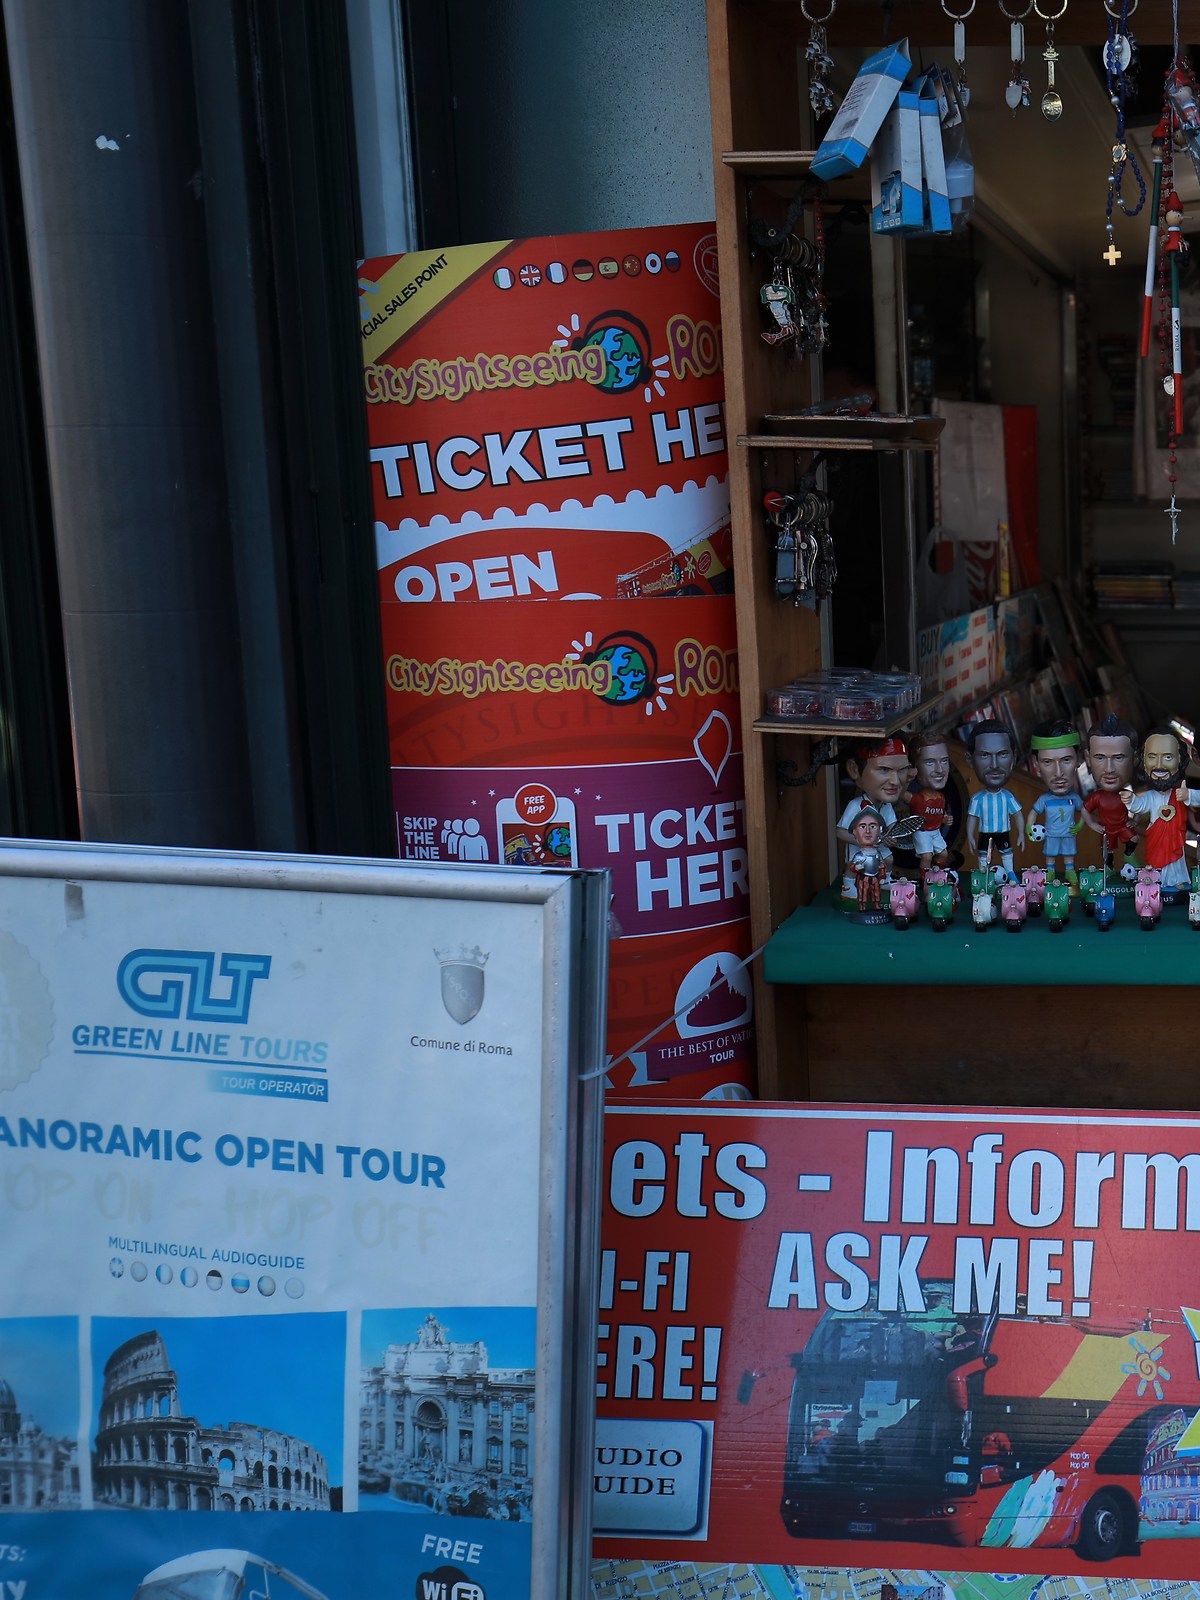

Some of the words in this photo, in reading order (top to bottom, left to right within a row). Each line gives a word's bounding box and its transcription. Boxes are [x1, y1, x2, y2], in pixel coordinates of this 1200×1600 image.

[384, 282, 418, 315] SALES
[414, 254, 448, 288] POINT
[370, 416, 633, 499] TICKET
[394, 549, 559, 601] OPEN
[386, 653, 613, 699] CitySightseeing
[524, 795, 545, 805] FREE
[527, 805, 546, 815] APP
[925, 806, 945, 816] ROMA
[403, 816, 438, 831] SKIP
[404, 831, 434, 846] THE
[405, 846, 440, 860] LINE
[116, 948, 272, 1024] GLT
[72, 1024, 163, 1051] GREEN
[171, 1030, 231, 1056] LINE
[239, 1035, 329, 1064] TOURS
[410, 1035, 460, 1051] Comune
[463, 1040, 476, 1052] di
[479, 1042, 513, 1056] Roma
[658, 1045, 685, 1060] THE
[688, 1039, 715, 1055] BEST
[716, 1036, 730, 1049] OF
[710, 1049, 735, 1064] TOUR
[221, 1075, 256, 1090] TOUR
[258, 1079, 326, 1097] OPERATOR
[214, 1133, 324, 1176] OPEN
[336, 1145, 446, 1190] TOUR
[608, 1130, 768, 1221] ets
[108, 1236, 207, 1262] MULTILINGUAL
[211, 1248, 305, 1270] AUDIOGUIDE
[767, 1231, 930, 1315] ASK
[952, 1235, 1096, 1318] ME!
[421, 1533, 484, 1565] FREE
